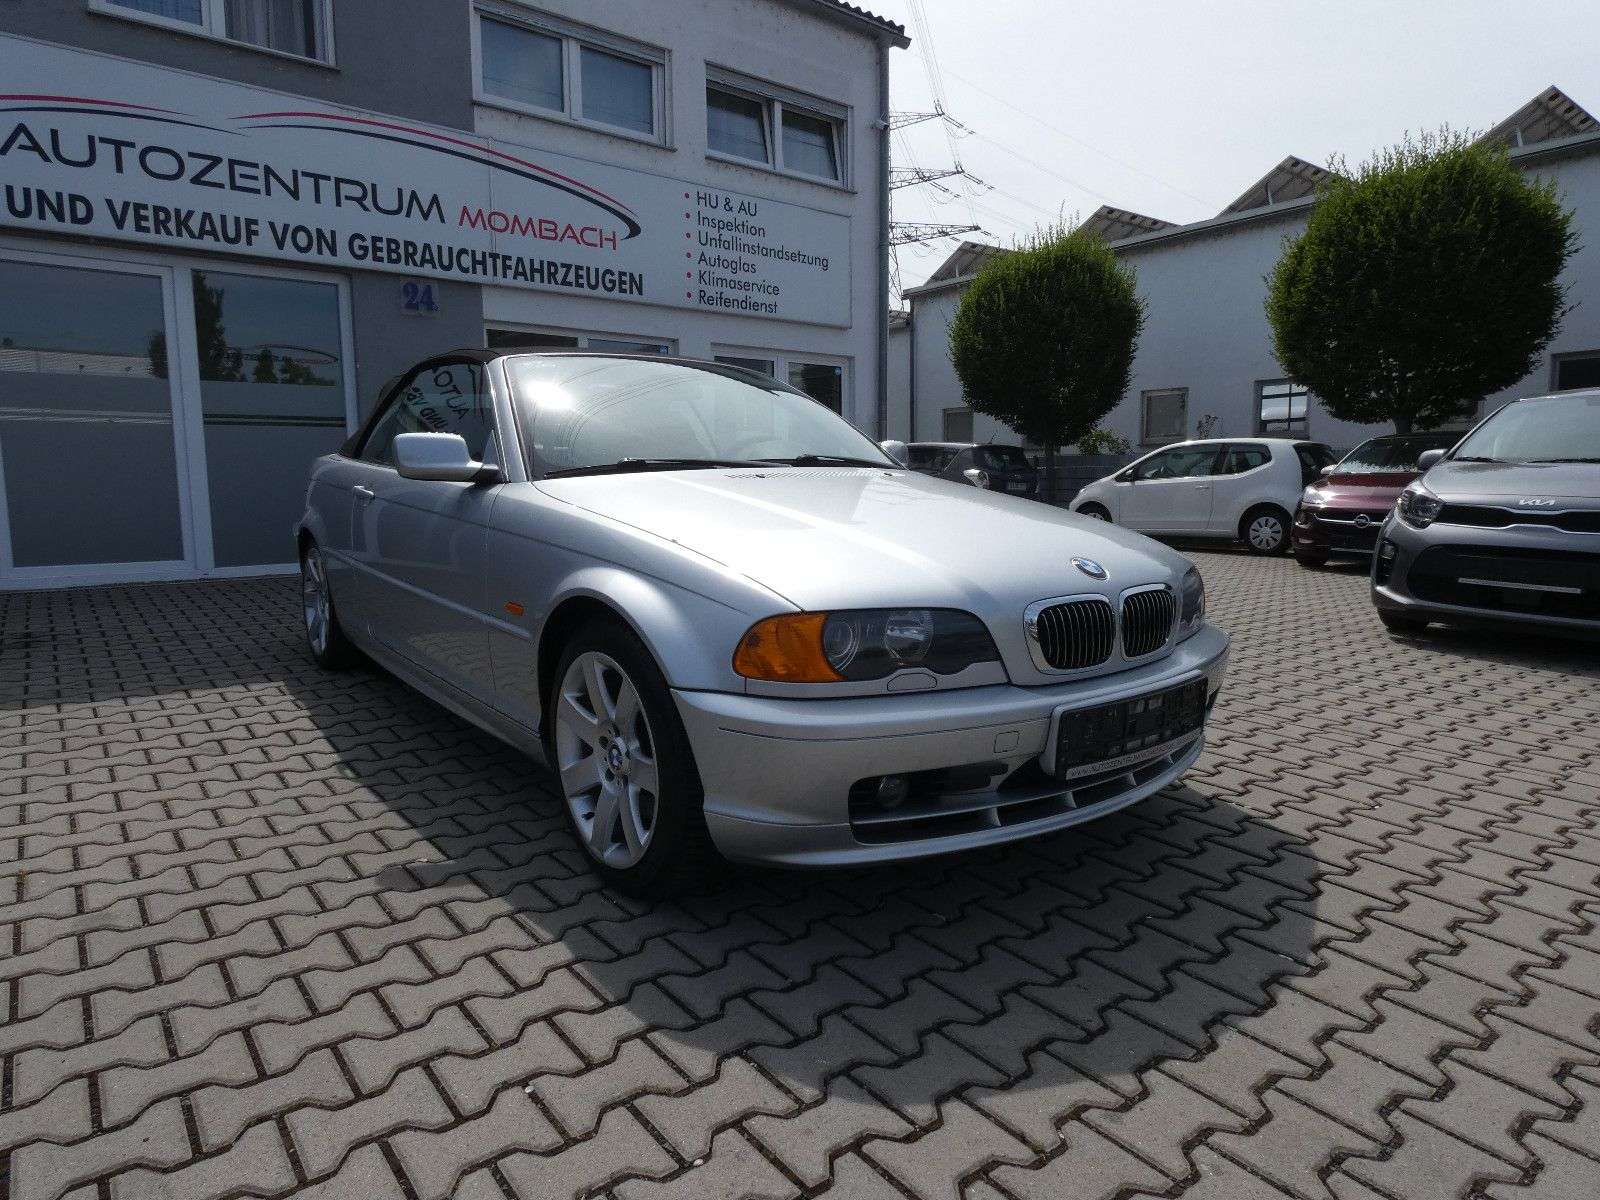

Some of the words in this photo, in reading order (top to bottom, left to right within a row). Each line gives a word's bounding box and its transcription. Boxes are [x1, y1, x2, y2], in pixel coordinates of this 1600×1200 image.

[0, 122, 446, 224] AUTOZENTRUM
[458, 205, 617, 250] MOMBACH
[696, 191, 719, 209] HU
[723, 197, 734, 212] &
[737, 200, 757, 217] AU
[697, 211, 766, 238] Inspektion
[5, 184, 94, 225] UND
[105, 198, 260, 246] VERKAUF
[268, 220, 338, 257] VON
[348, 232, 643, 296] GEBRAUCHTFAHRZEUGEN
[698, 231, 829, 271] Unfallinstandsetzung
[698, 251, 757, 275] Autoglas
[403, 282, 435, 311] 24
[699, 270, 780, 296] Klimaservice
[699, 289, 778, 314] Reifendienst
